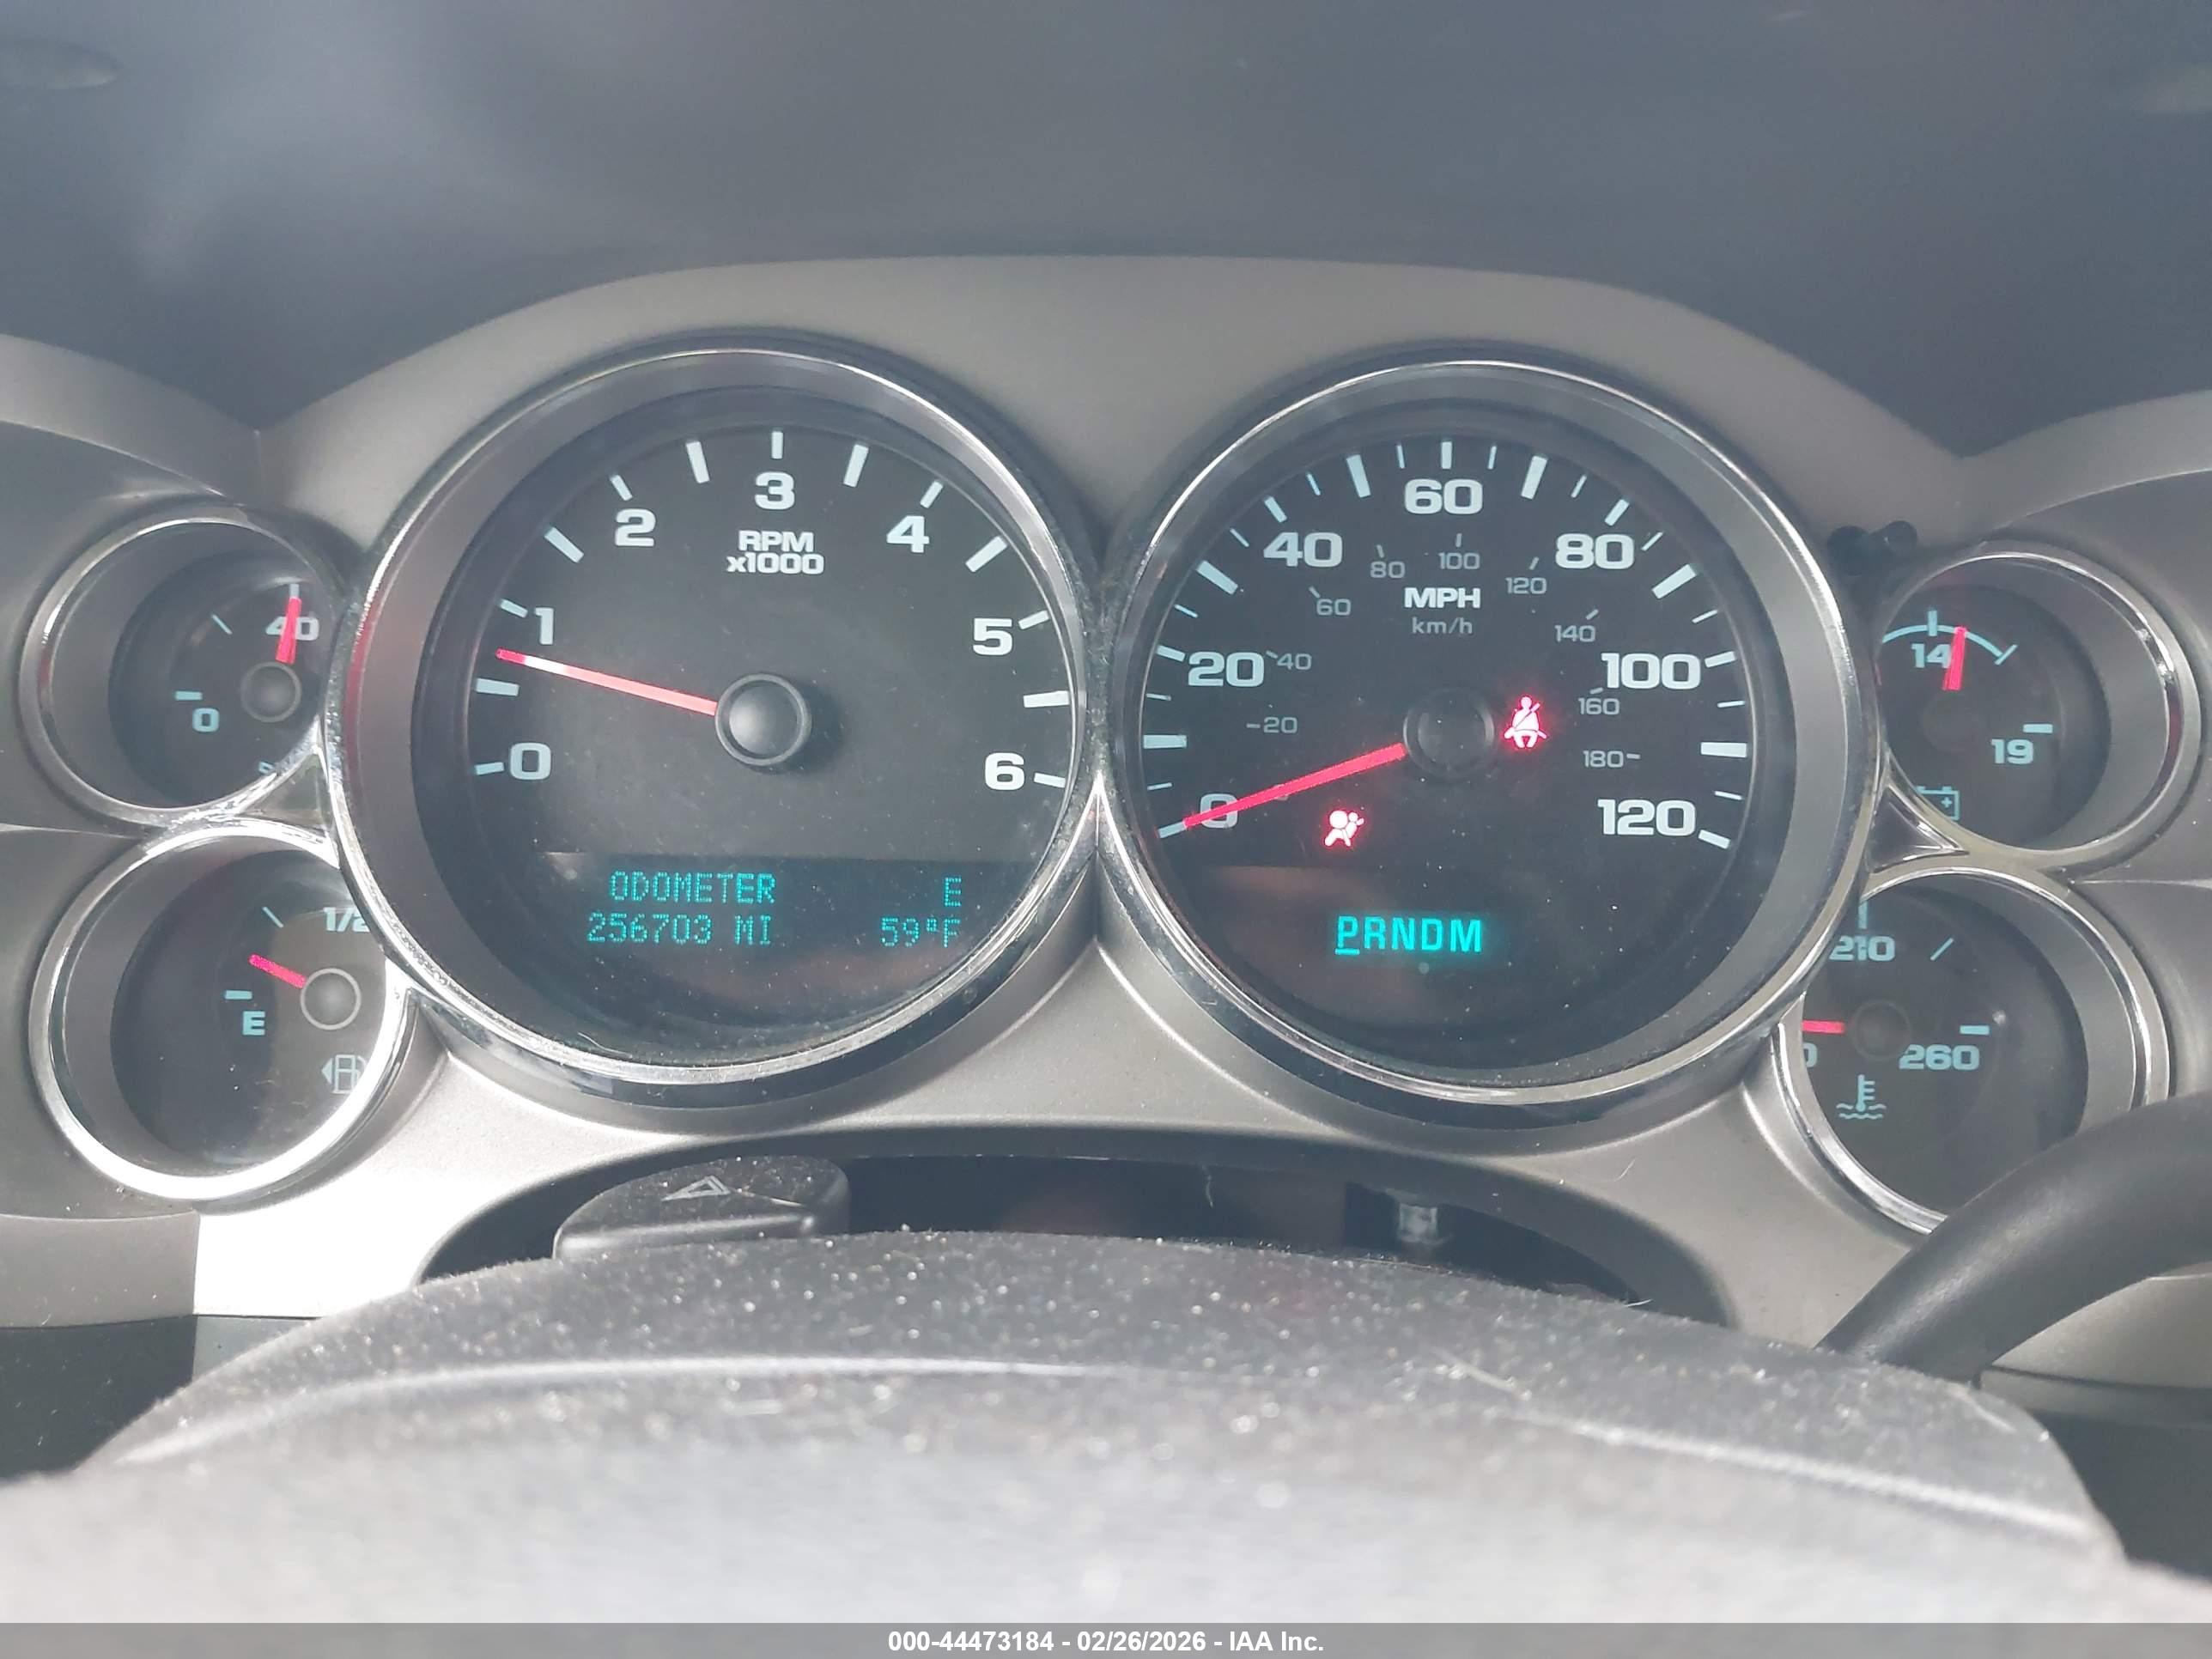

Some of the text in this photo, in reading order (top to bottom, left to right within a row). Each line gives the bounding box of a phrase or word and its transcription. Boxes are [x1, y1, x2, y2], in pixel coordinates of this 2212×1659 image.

[755, 471, 795, 510] 3
[1404, 478, 1483, 515] 60
[614, 508, 656, 547] 2
[886, 516, 930, 553] 4
[738, 531, 814, 552] RPM
[1263, 532, 1343, 568] 40
[1555, 533, 1634, 569] 80
[726, 552, 824, 574] x1000
[1370, 562, 1406, 579] 80
[1438, 552, 1480, 570] 100
[1404, 587, 1481, 608] MPH
[1505, 577, 1547, 594] 120
[1316, 599, 1352, 616] 60
[534, 606, 555, 645] 1
[973, 618, 1012, 657] 5
[1412, 617, 1473, 635] km/h
[1554, 625, 1596, 642] 140
[1188, 651, 1265, 687] 20
[1276, 653, 1312, 670] 40
[1911, 643, 1953, 668] 14
[1601, 653, 1701, 690] 100
[192, 708, 220, 732] 0
[1578, 698, 1620, 715] 160
[1263, 717, 1297, 733] 20
[509, 743, 551, 781] 0
[1583, 750, 1624, 768] 180
[1990, 738, 2034, 764] 19
[984, 752, 1024, 791] 6
[1200, 793, 1238, 829] 0
[1597, 799, 1697, 836] 120
[609, 871, 776, 903] ODOMETER
[945, 877, 963, 907] E
[586, 912, 773, 945] 256703 MI
[1334, 915, 1483, 955] PRNDM
[1829, 936, 1895, 962] 210
[242, 1011, 265, 1036] E
[1899, 1044, 1980, 1071] 260
